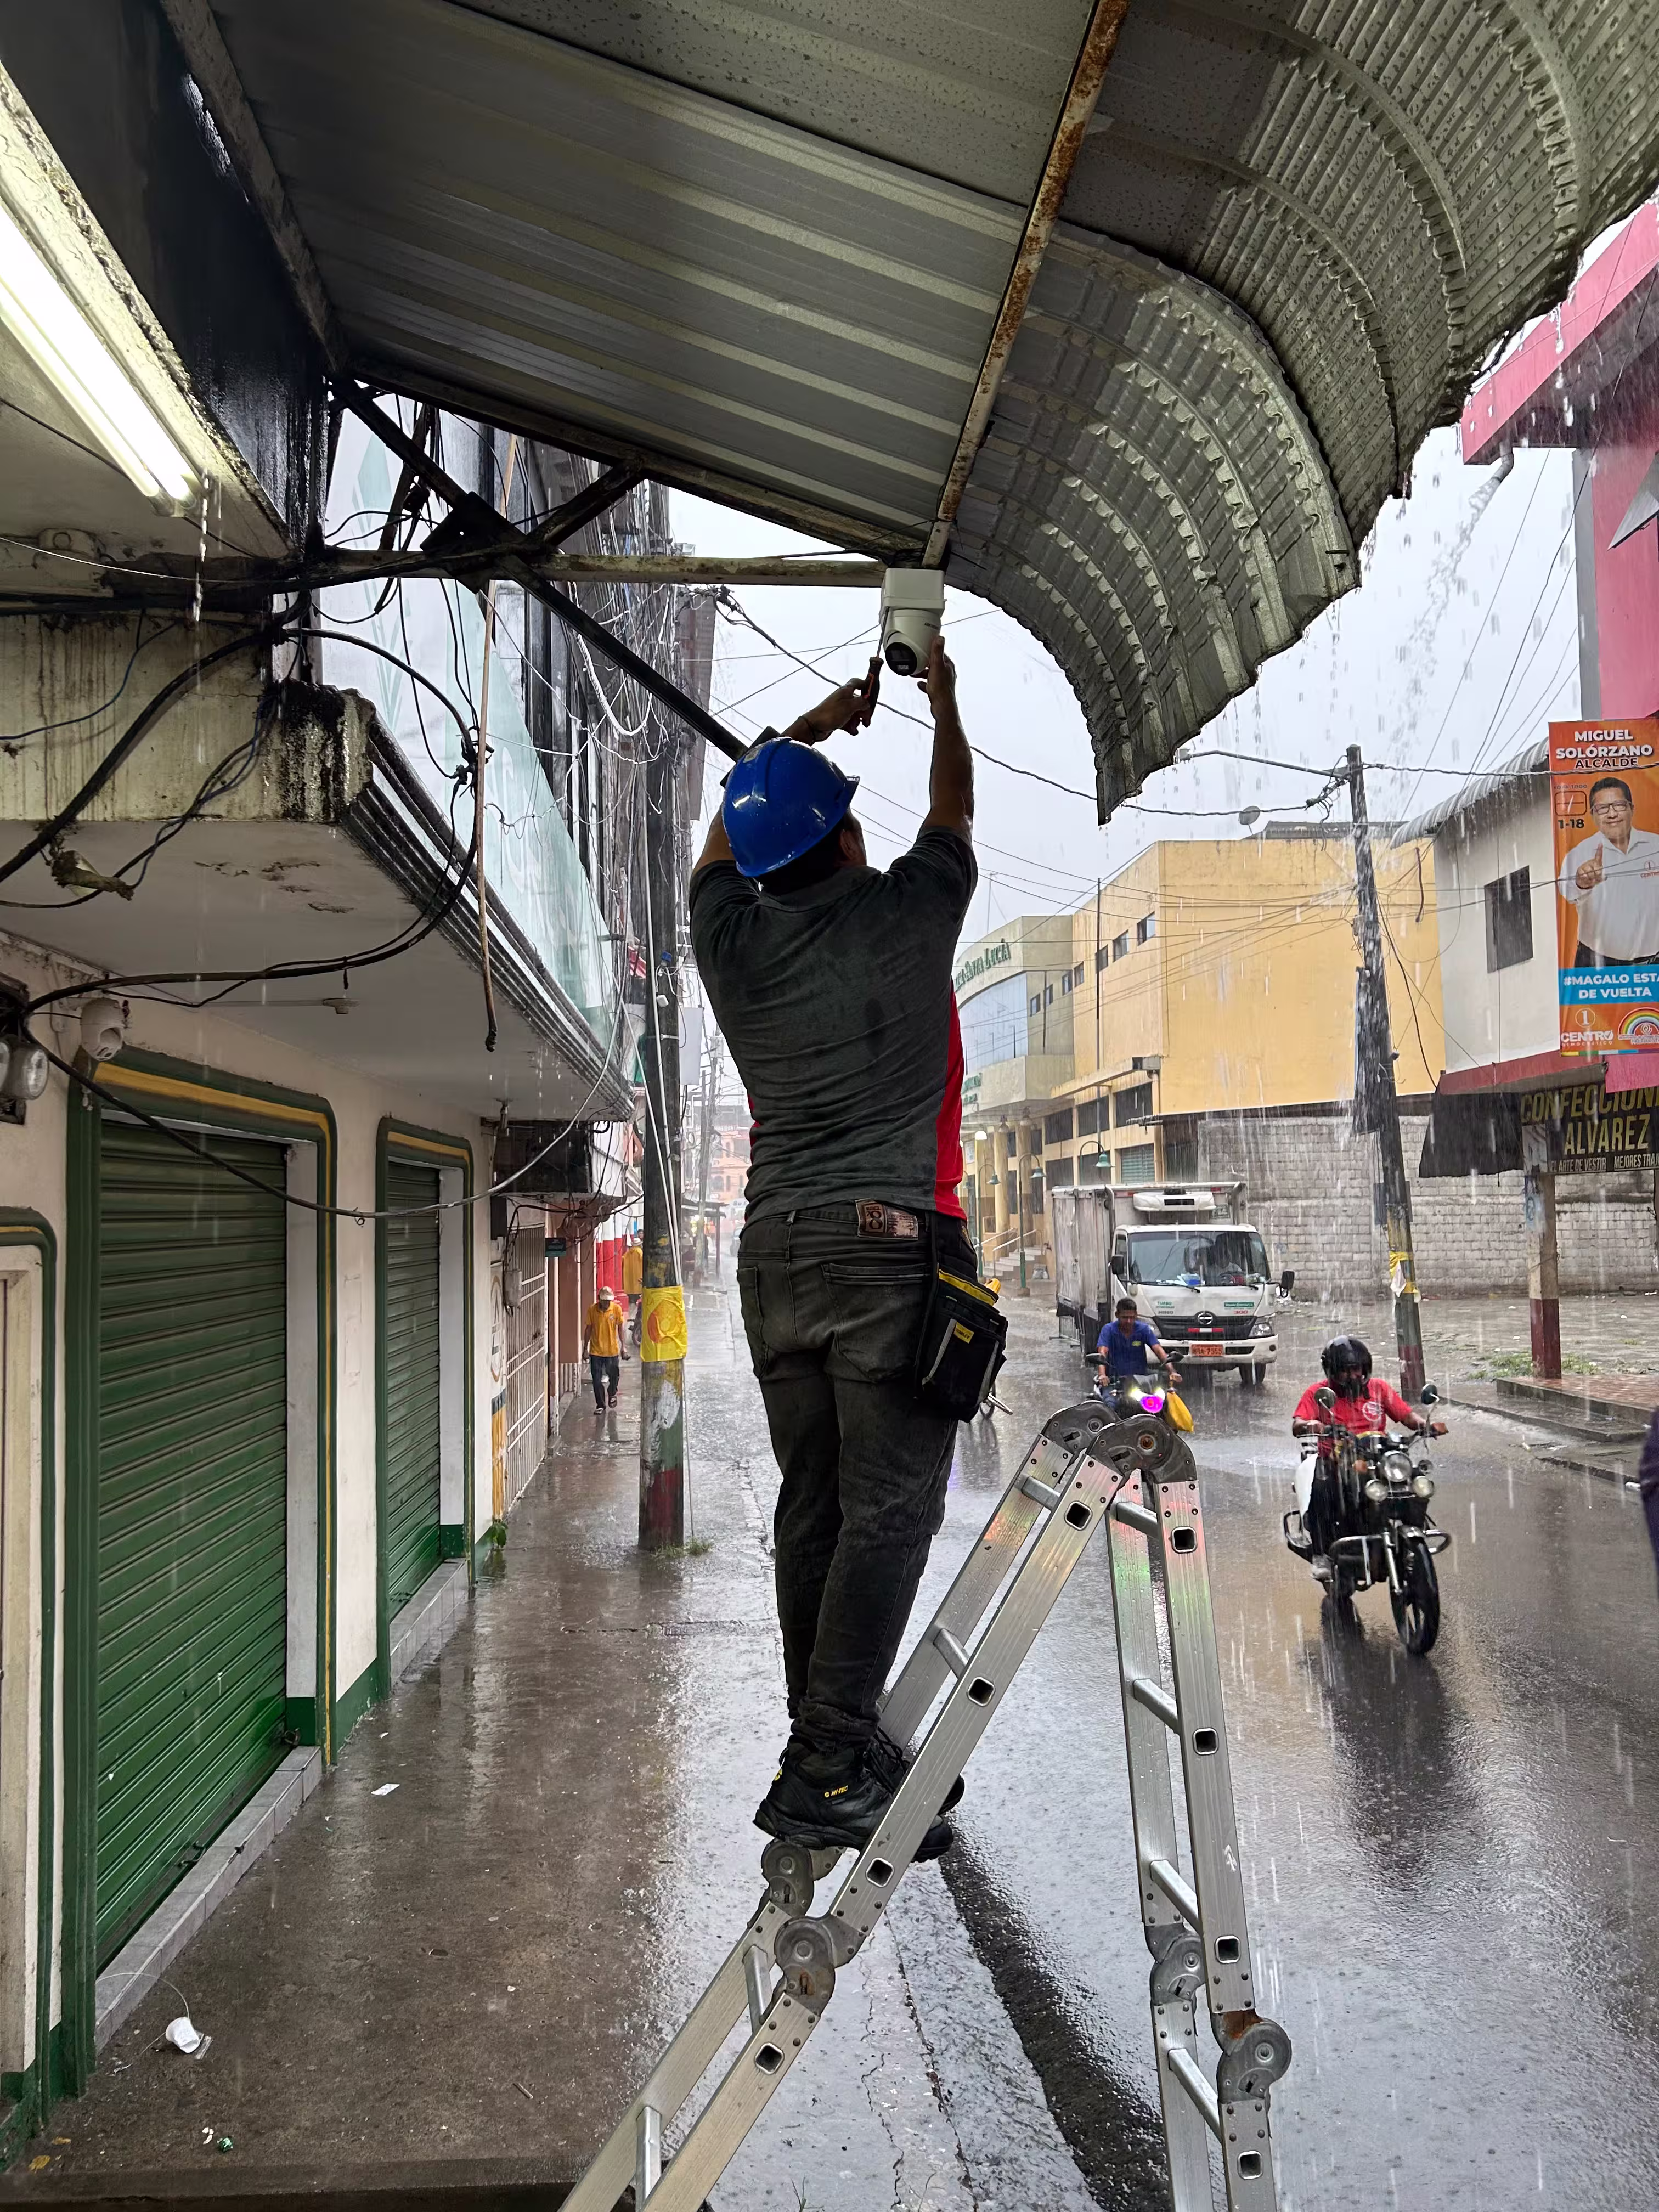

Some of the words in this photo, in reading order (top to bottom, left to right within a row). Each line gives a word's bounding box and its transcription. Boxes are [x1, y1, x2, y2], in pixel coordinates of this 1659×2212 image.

[1574, 729, 1633, 742] MIGUEL
[1555, 743, 1653, 759] SOLÓRZANO
[1575, 757, 1638, 769] ALCALDE
[1558, 819, 1585, 830] 1-18
[1563, 974, 1630, 986] #MAGALO
[1633, 973, 1659, 983] EST
[1578, 989, 1597, 999] DE
[1600, 986, 1652, 998] VUELTA
[1560, 1030, 1614, 1042] CENTRO
[1520, 1082, 1659, 1123] CONFECCION
[1564, 1113, 1650, 1155] ALVAREZ
[1559, 1159, 1574, 1172] ARTE
[1575, 1159, 1583, 1171] DE
[1584, 1157, 1607, 1171] VESTIR
[1614, 1154, 1641, 1169] MEJORES
[1643, 1153, 1659, 1167] TRAJ
